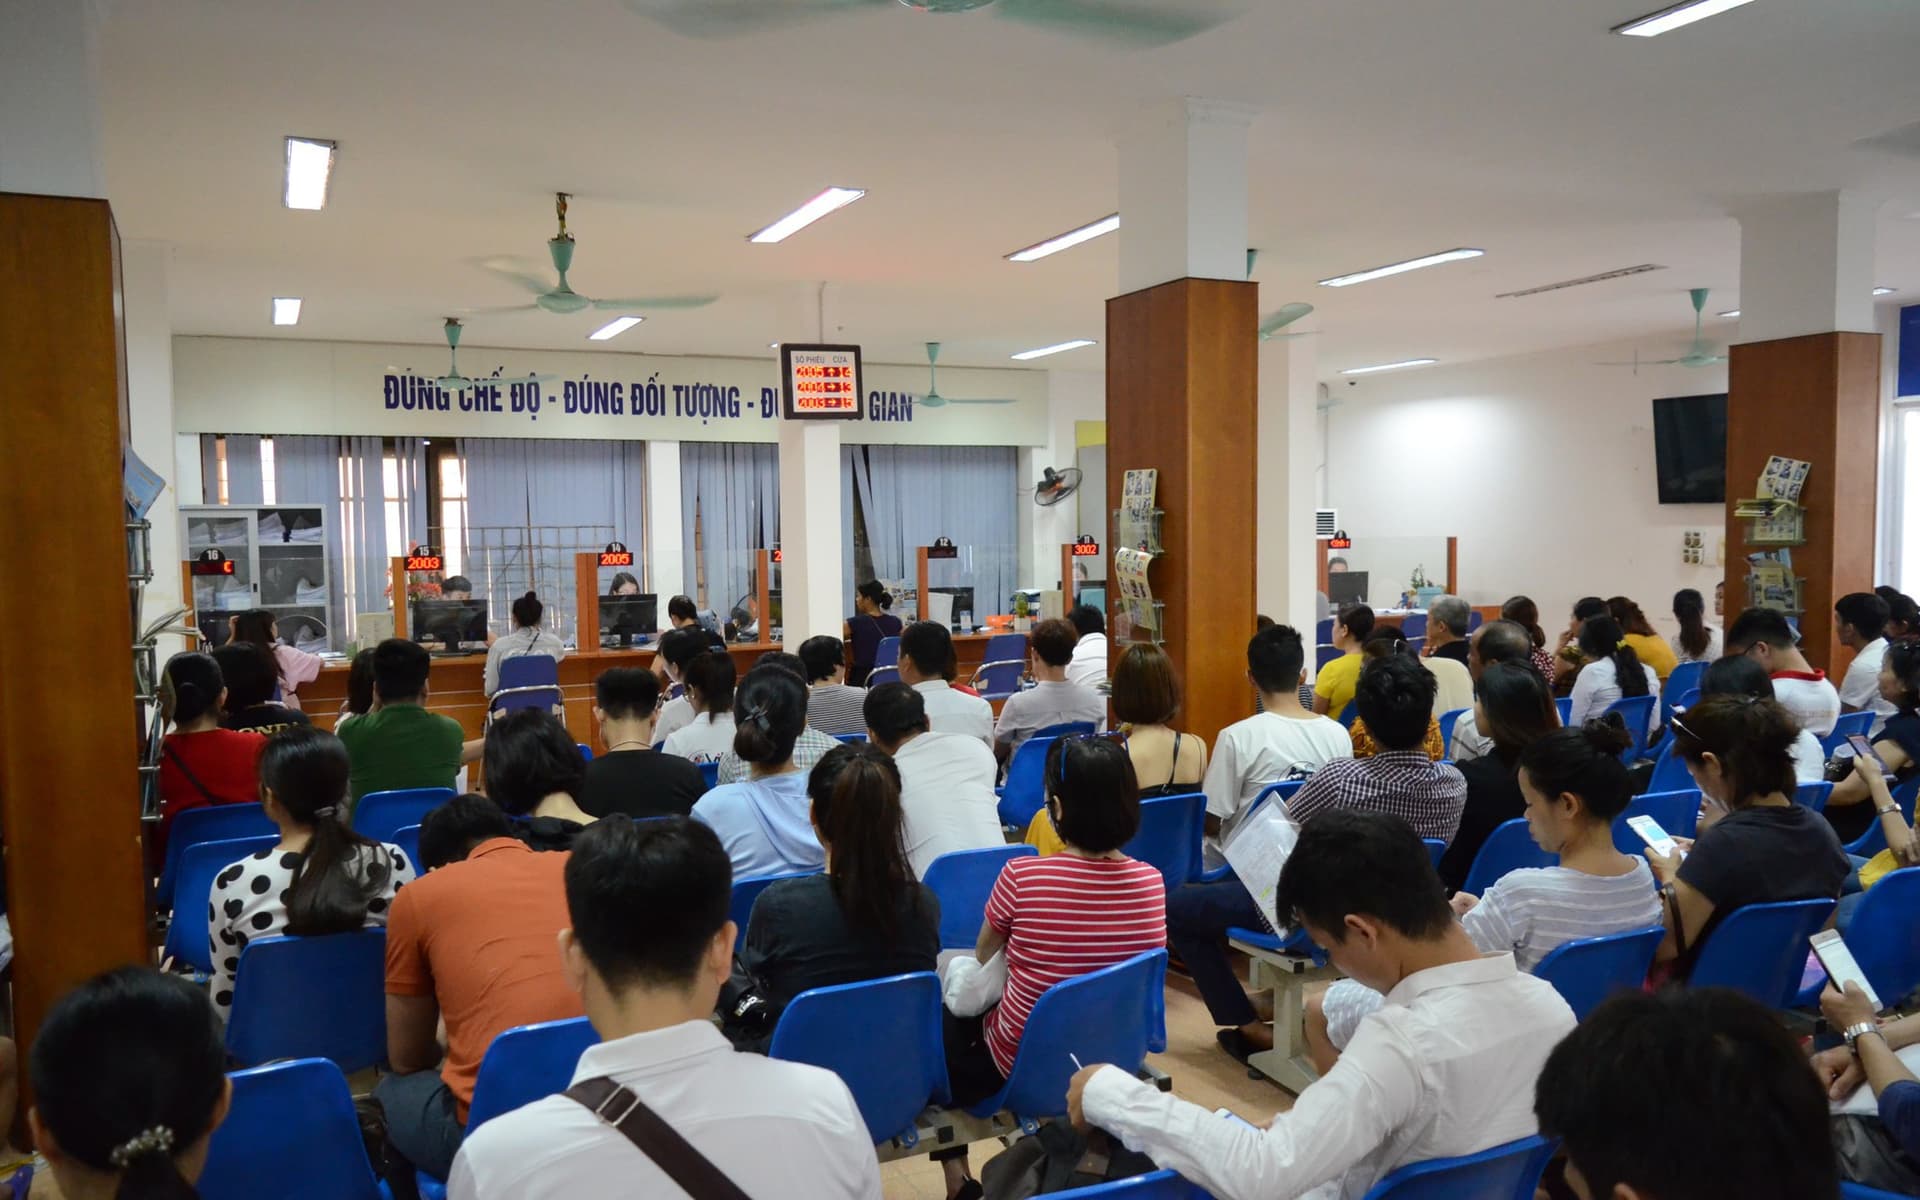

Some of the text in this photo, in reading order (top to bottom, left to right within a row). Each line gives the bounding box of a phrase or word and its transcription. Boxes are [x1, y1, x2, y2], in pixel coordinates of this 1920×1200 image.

[563, 374, 624, 415] ĐÚNG
[630, 372, 666, 416] ĐỐI
[673, 381, 741, 425] TƯỢNG
[869, 391, 913, 422] GIAN
[940, 538, 949, 547] 12
[207, 550, 219, 560] 16
[420, 546, 430, 556] 15
[1075, 544, 1097, 555] 3002
[407, 557, 440, 569] 2003
[601, 553, 630, 565] 2005
